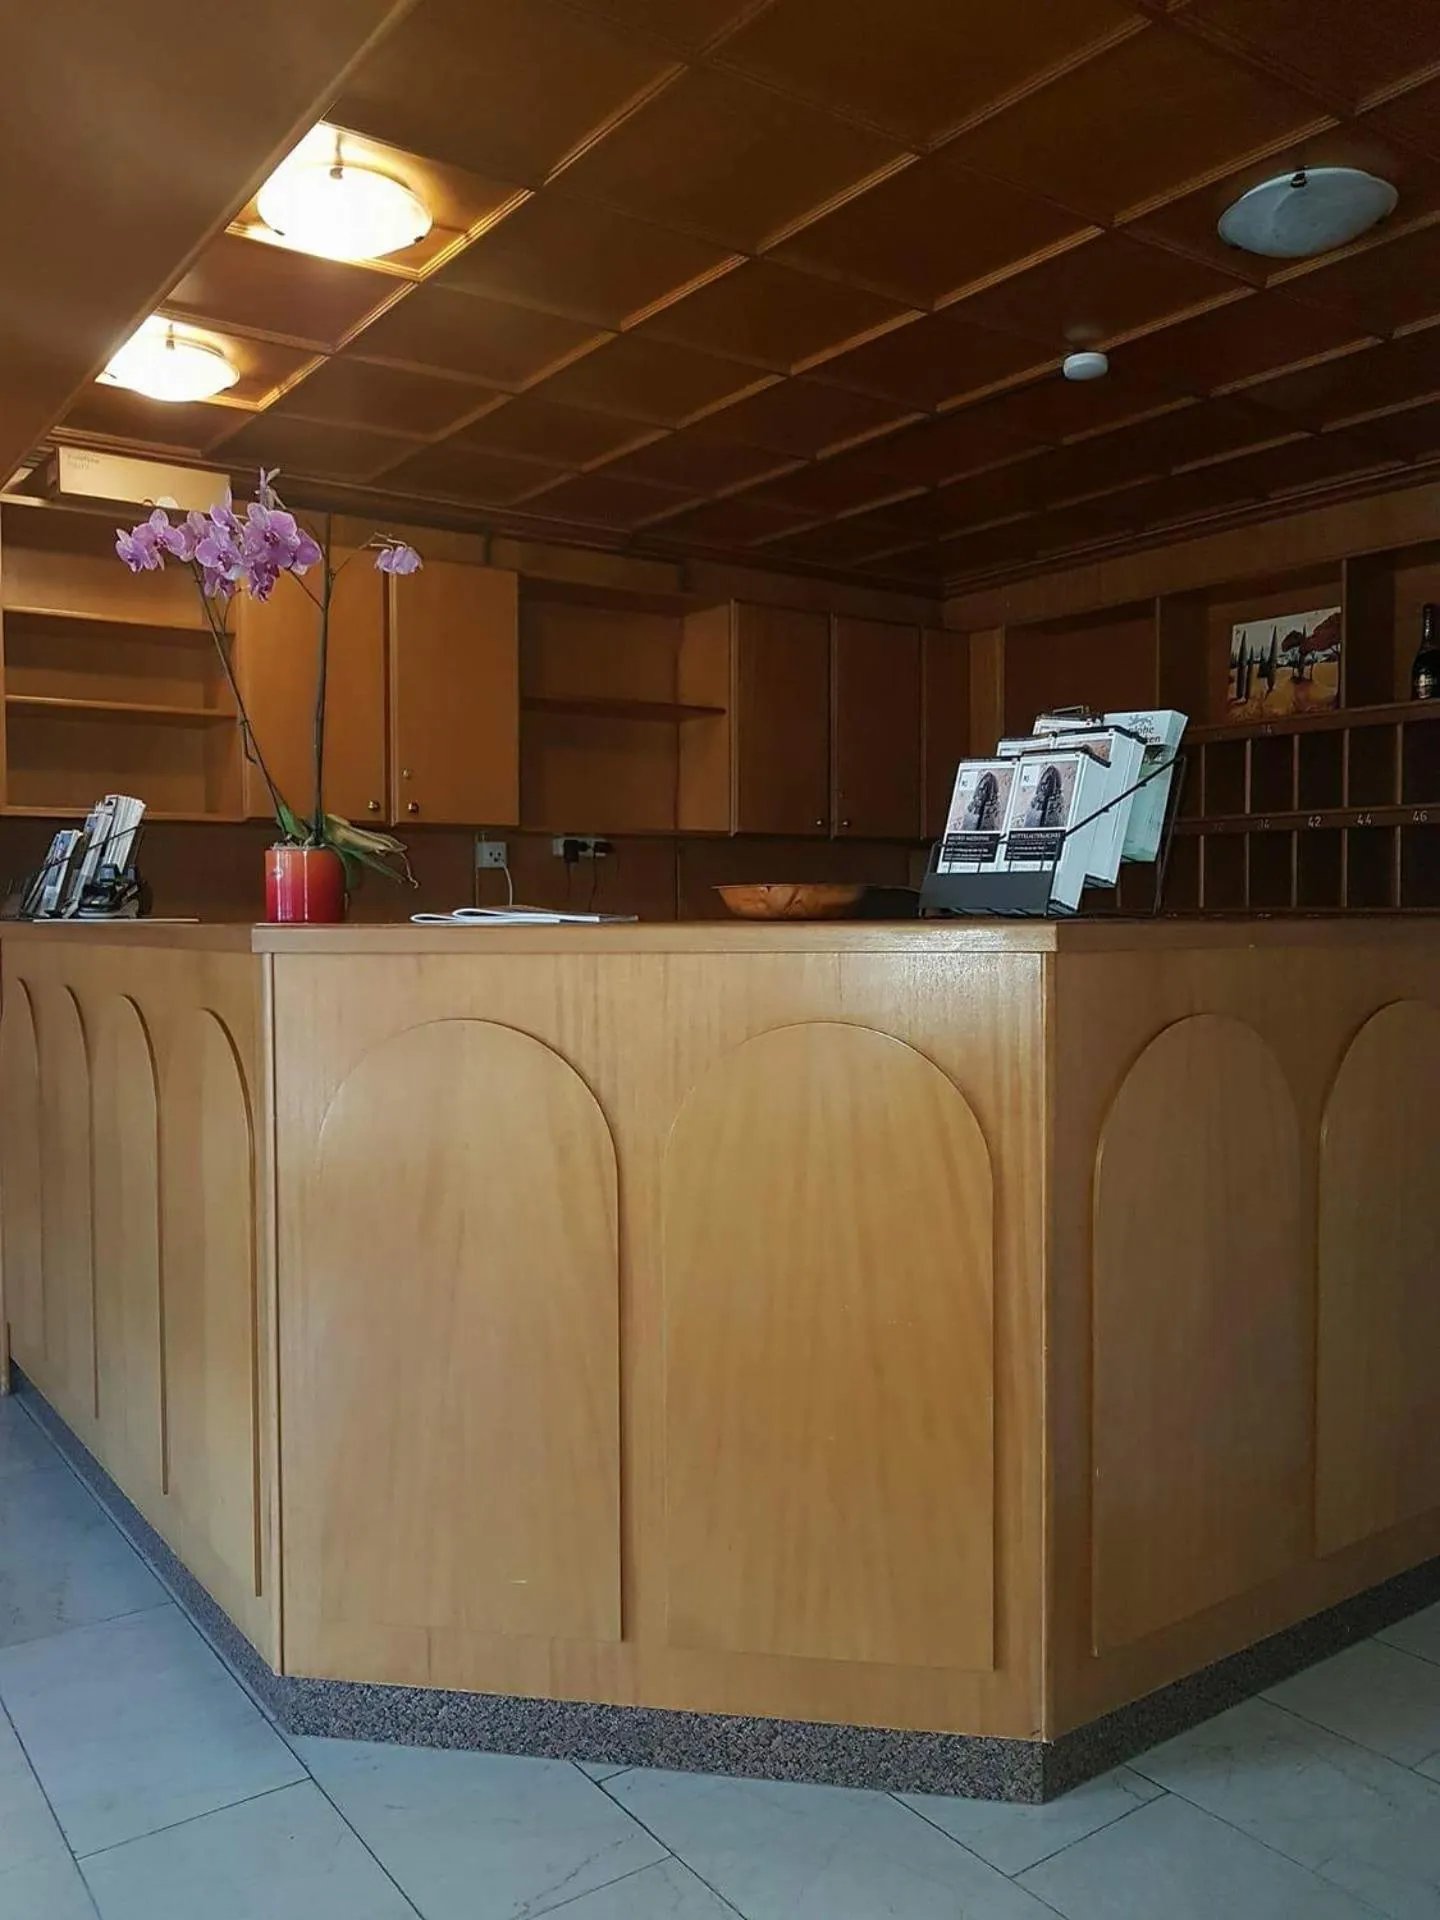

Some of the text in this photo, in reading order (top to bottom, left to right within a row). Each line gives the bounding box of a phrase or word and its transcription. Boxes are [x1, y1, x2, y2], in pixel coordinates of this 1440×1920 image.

[1307, 816, 1322, 828] 42
[1357, 813, 1372, 825] 44
[1412, 810, 1428, 823] 46
